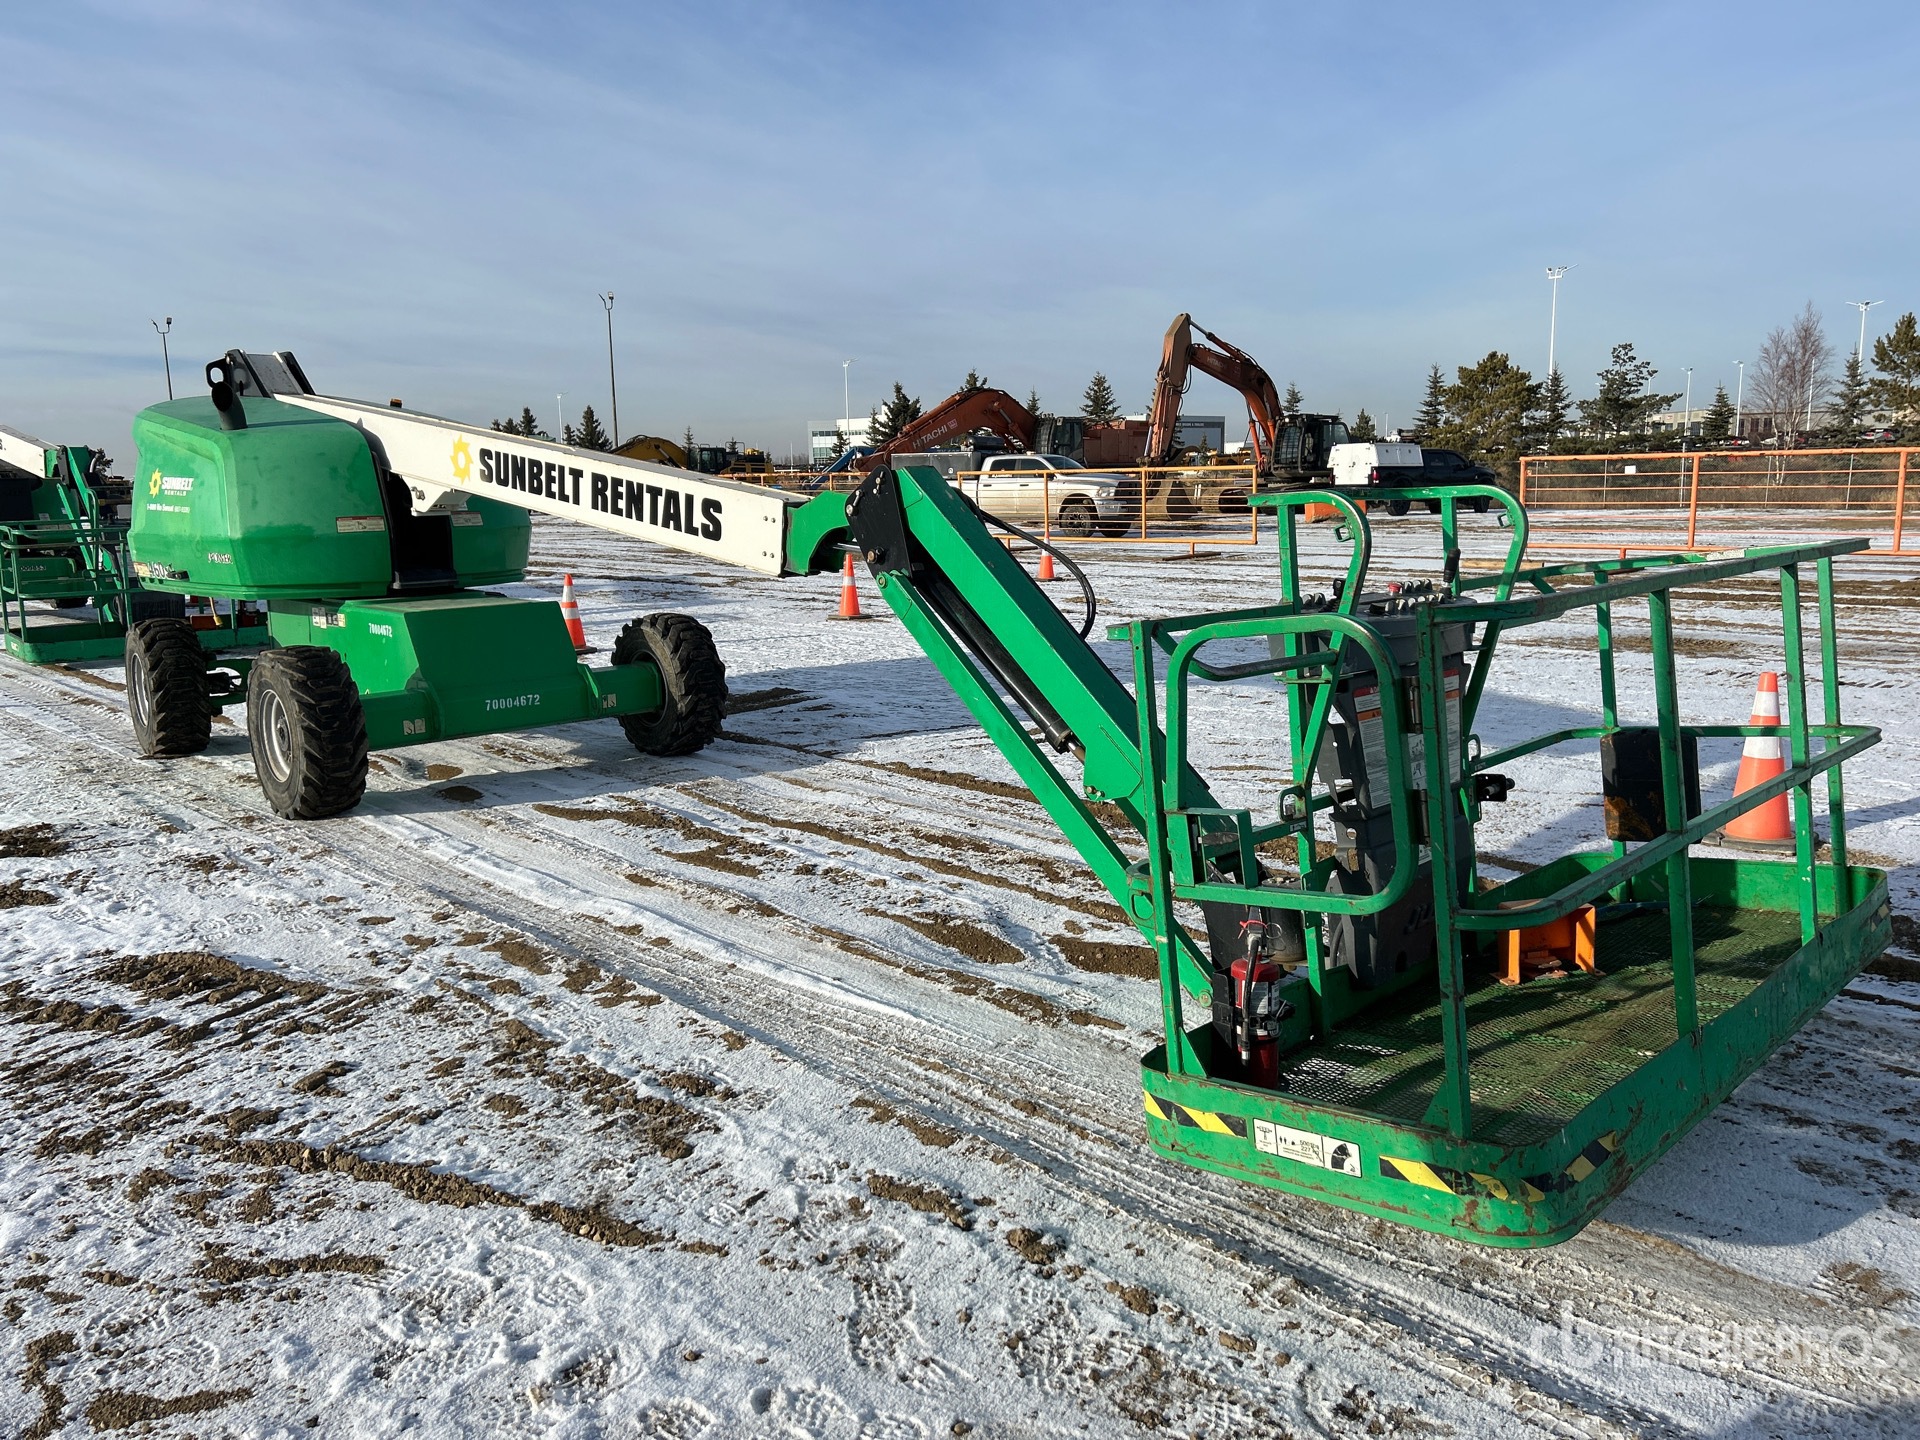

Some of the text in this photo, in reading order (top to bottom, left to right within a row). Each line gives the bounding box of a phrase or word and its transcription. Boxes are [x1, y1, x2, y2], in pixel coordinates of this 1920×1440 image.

[912, 424, 948, 449] HITACHI
[161, 476, 195, 491] SUNBELT
[478, 447, 723, 542] SUNBELT RENTALS
[485, 693, 541, 712] 70004672
